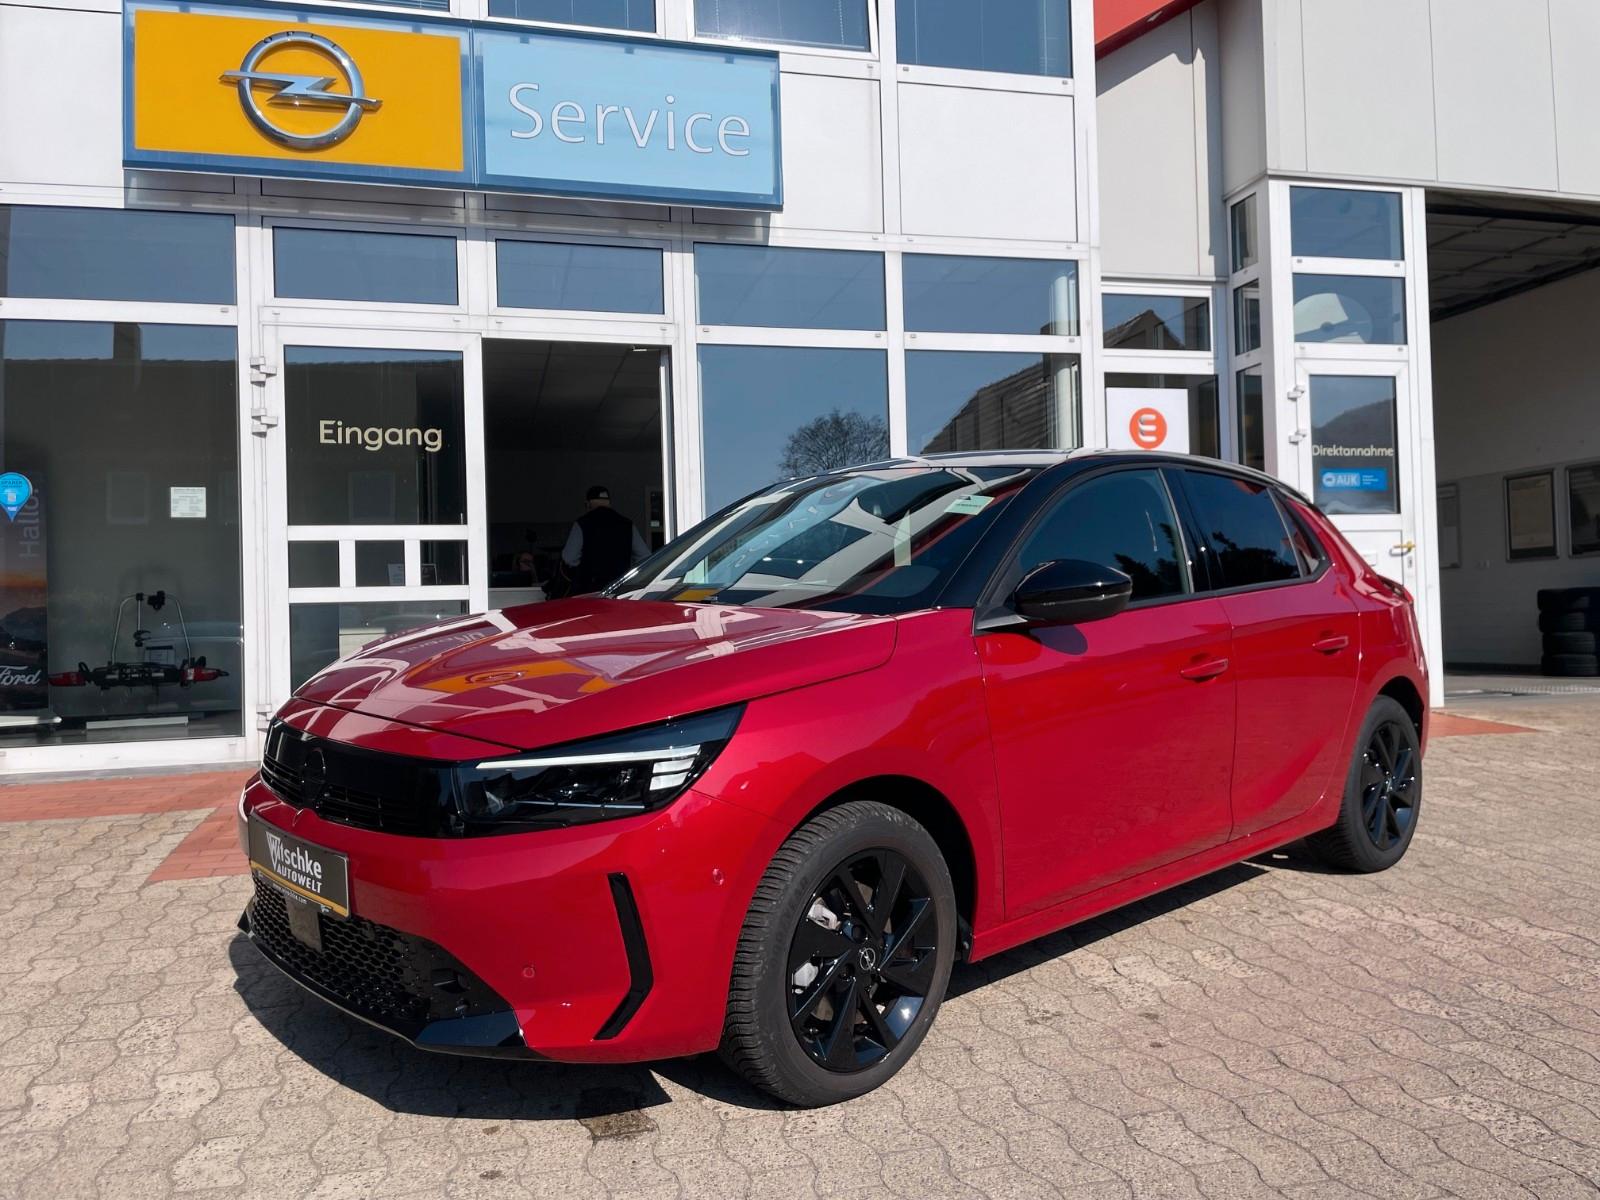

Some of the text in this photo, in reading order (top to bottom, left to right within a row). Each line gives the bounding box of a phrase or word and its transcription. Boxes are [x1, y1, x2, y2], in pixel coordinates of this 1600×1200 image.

[508, 82, 750, 156] Service
[320, 420, 442, 452] Eingang
[1312, 444, 1394, 456] Direktannahme
[0, 665, 41, 685] Ford
[276, 863, 323, 894] AUTOWELT
